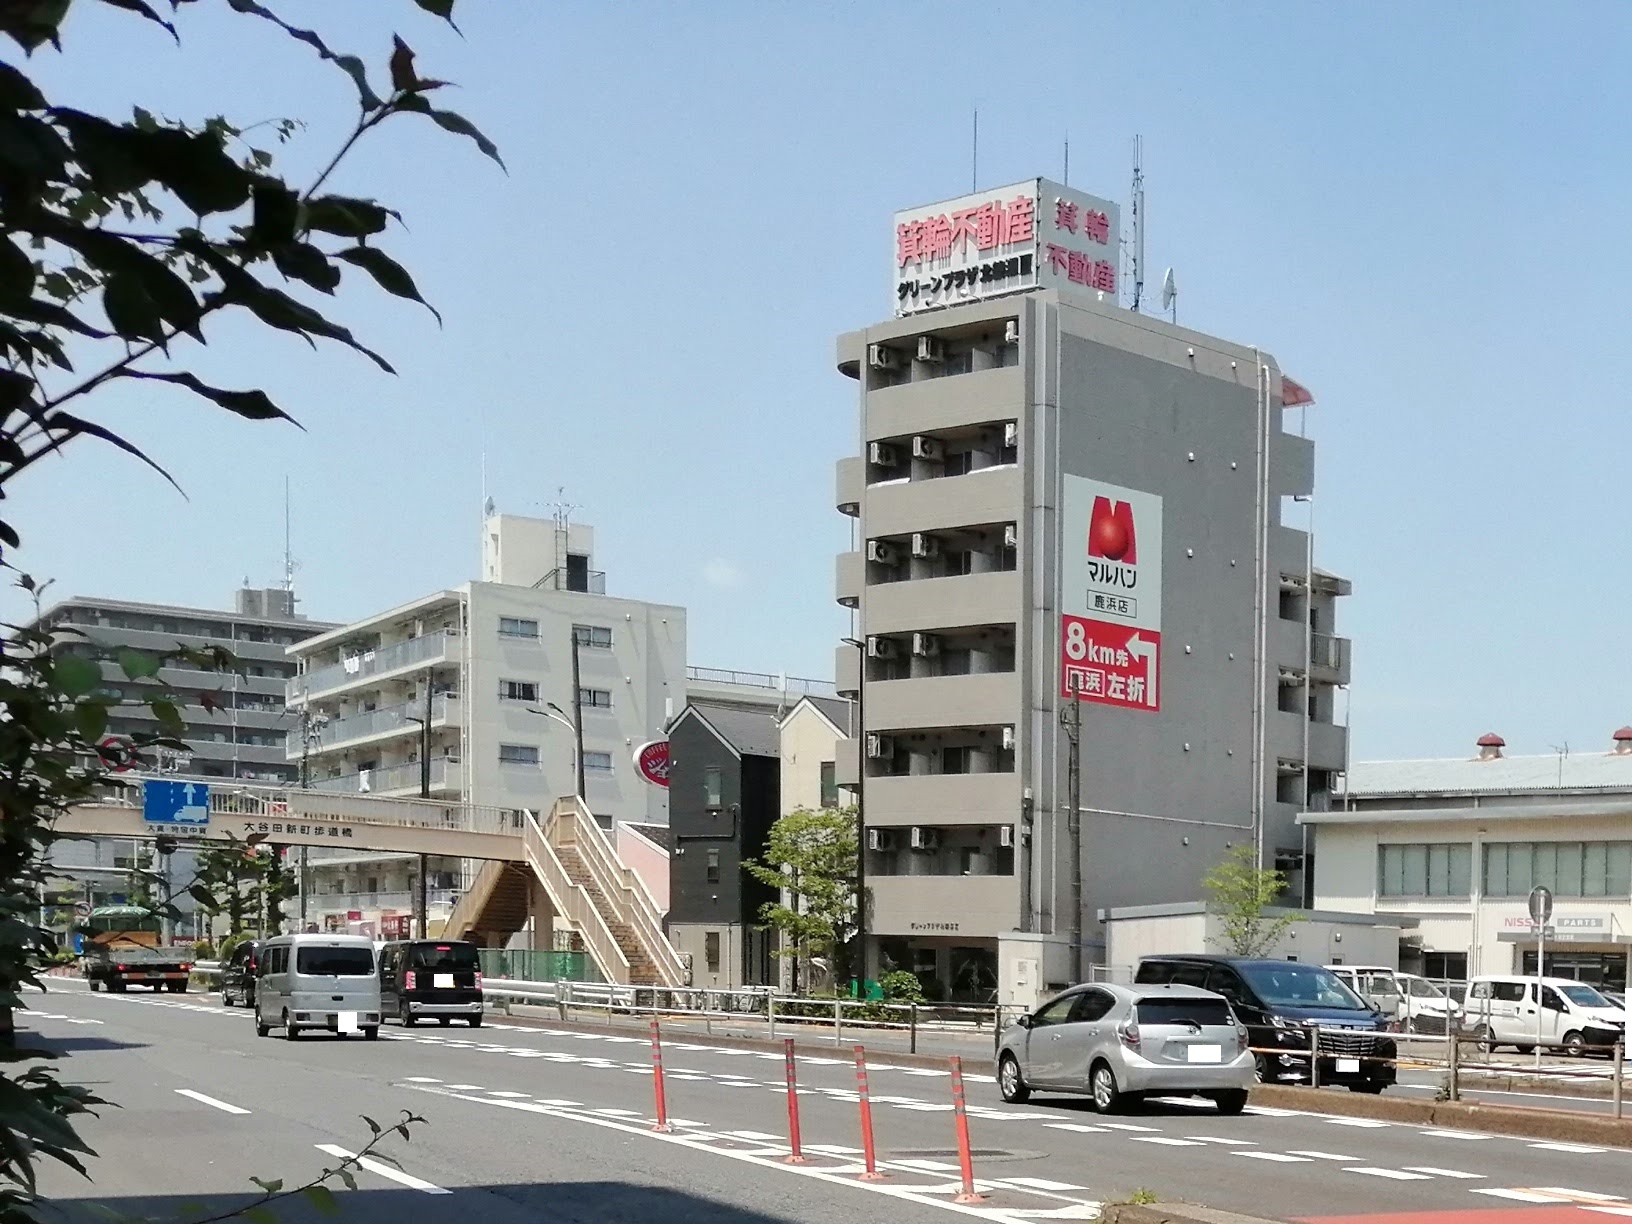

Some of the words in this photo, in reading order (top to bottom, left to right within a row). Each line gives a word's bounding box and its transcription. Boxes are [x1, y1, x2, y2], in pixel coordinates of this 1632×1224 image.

[897, 194, 1034, 268] 箕輪不動産
[1054, 198, 1110, 245] 箕輪
[1045, 242, 1116, 294] 不動産
[1087, 561, 1137, 589] マルハン
[1094, 594, 1129, 614] 鹿浜店
[1107, 672, 1145, 703] 左折
[244, 821, 353, 838] 大谷田新町歩道橋
[1504, 917, 1550, 928] NISS
[1563, 918, 1597, 927] PARTS
